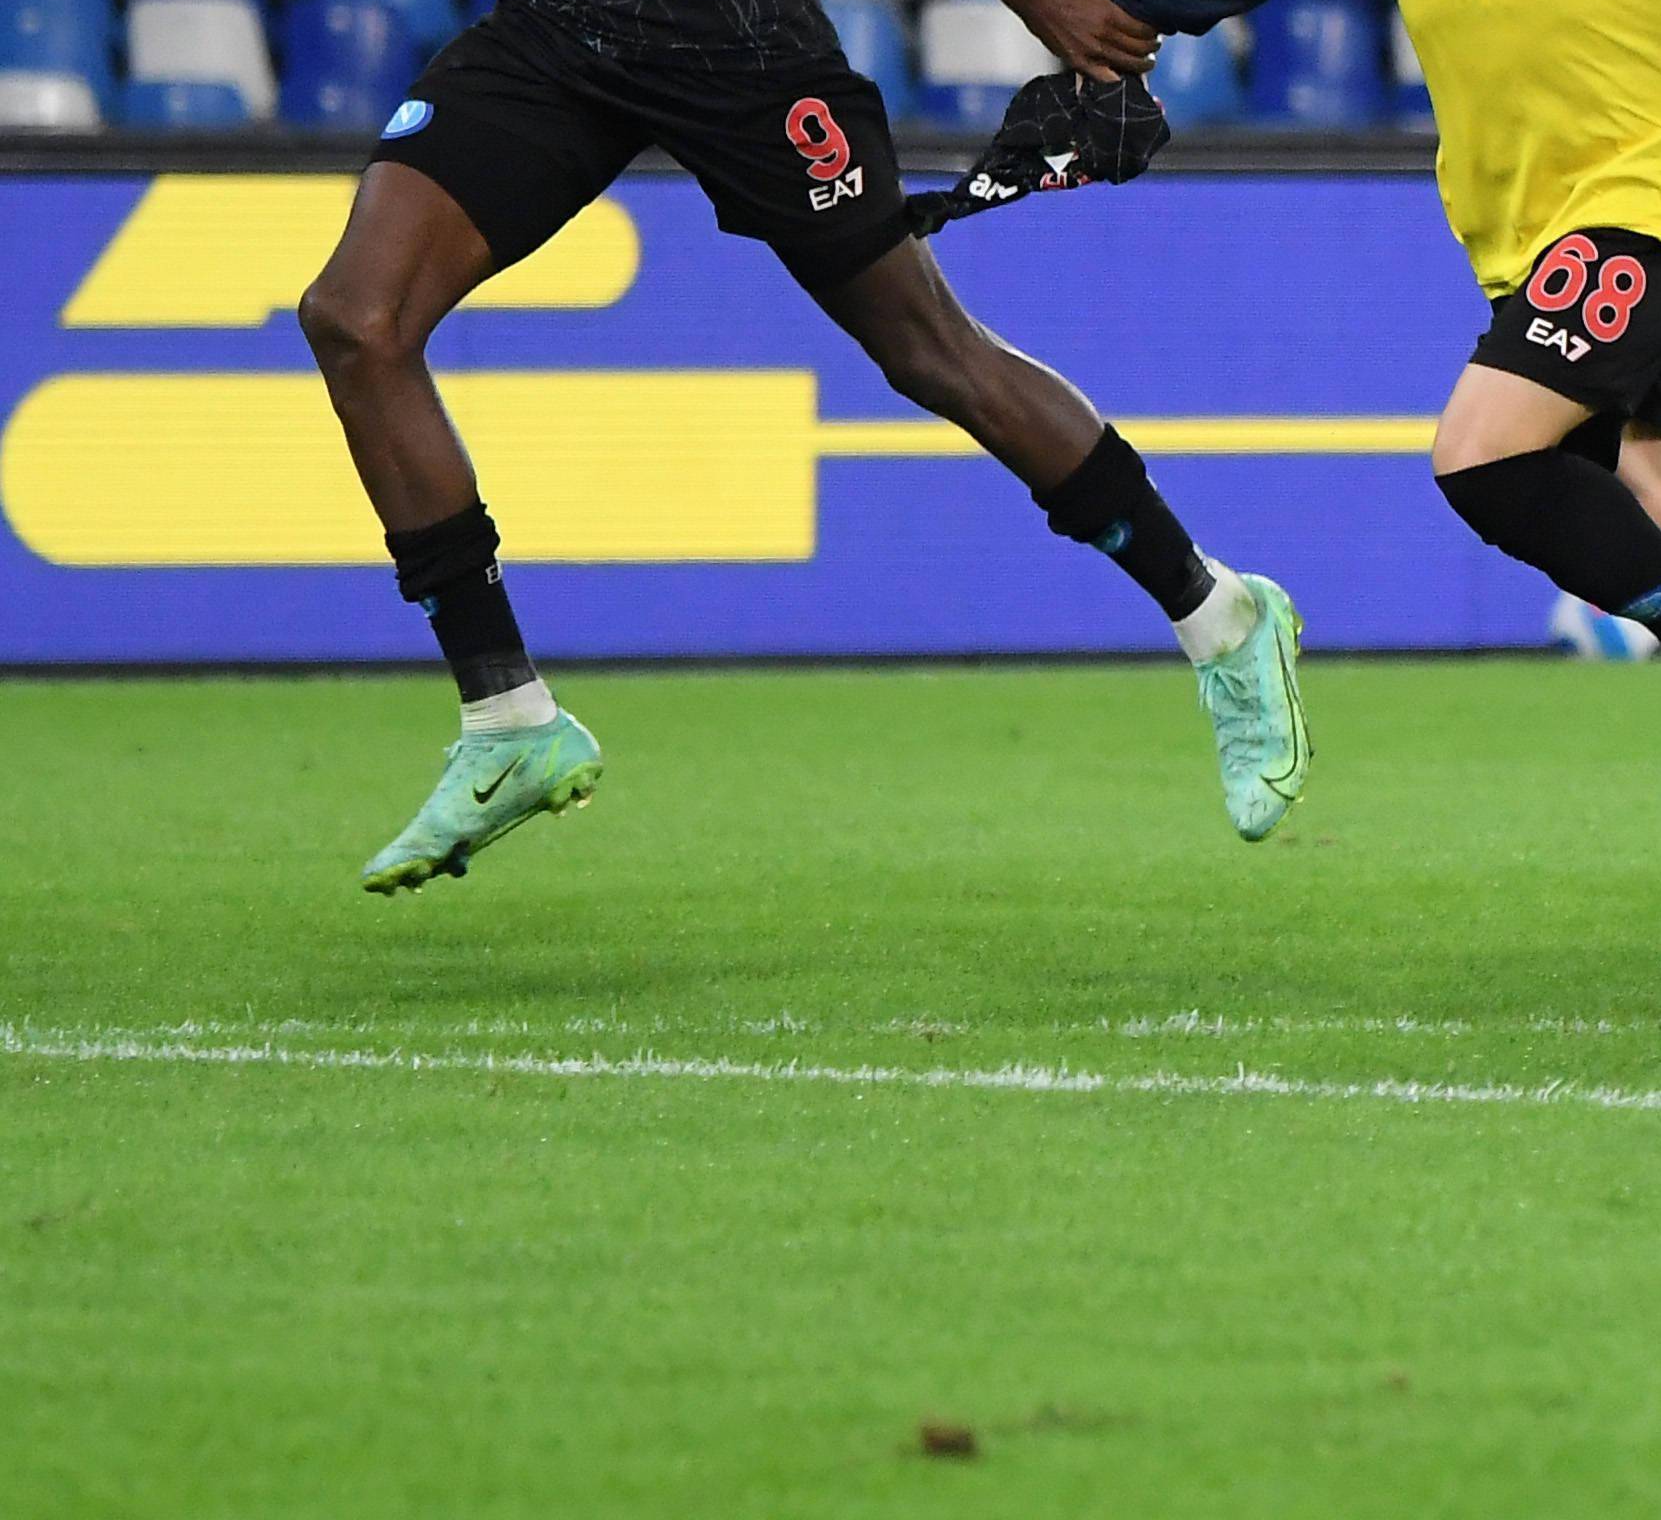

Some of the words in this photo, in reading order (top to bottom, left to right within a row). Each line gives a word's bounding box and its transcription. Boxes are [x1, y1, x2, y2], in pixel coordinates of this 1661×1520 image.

[785, 97, 850, 181] 9
[809, 166, 863, 211] EA7
[1526, 234, 1646, 343] 68
[1525, 317, 1592, 362] EA7
